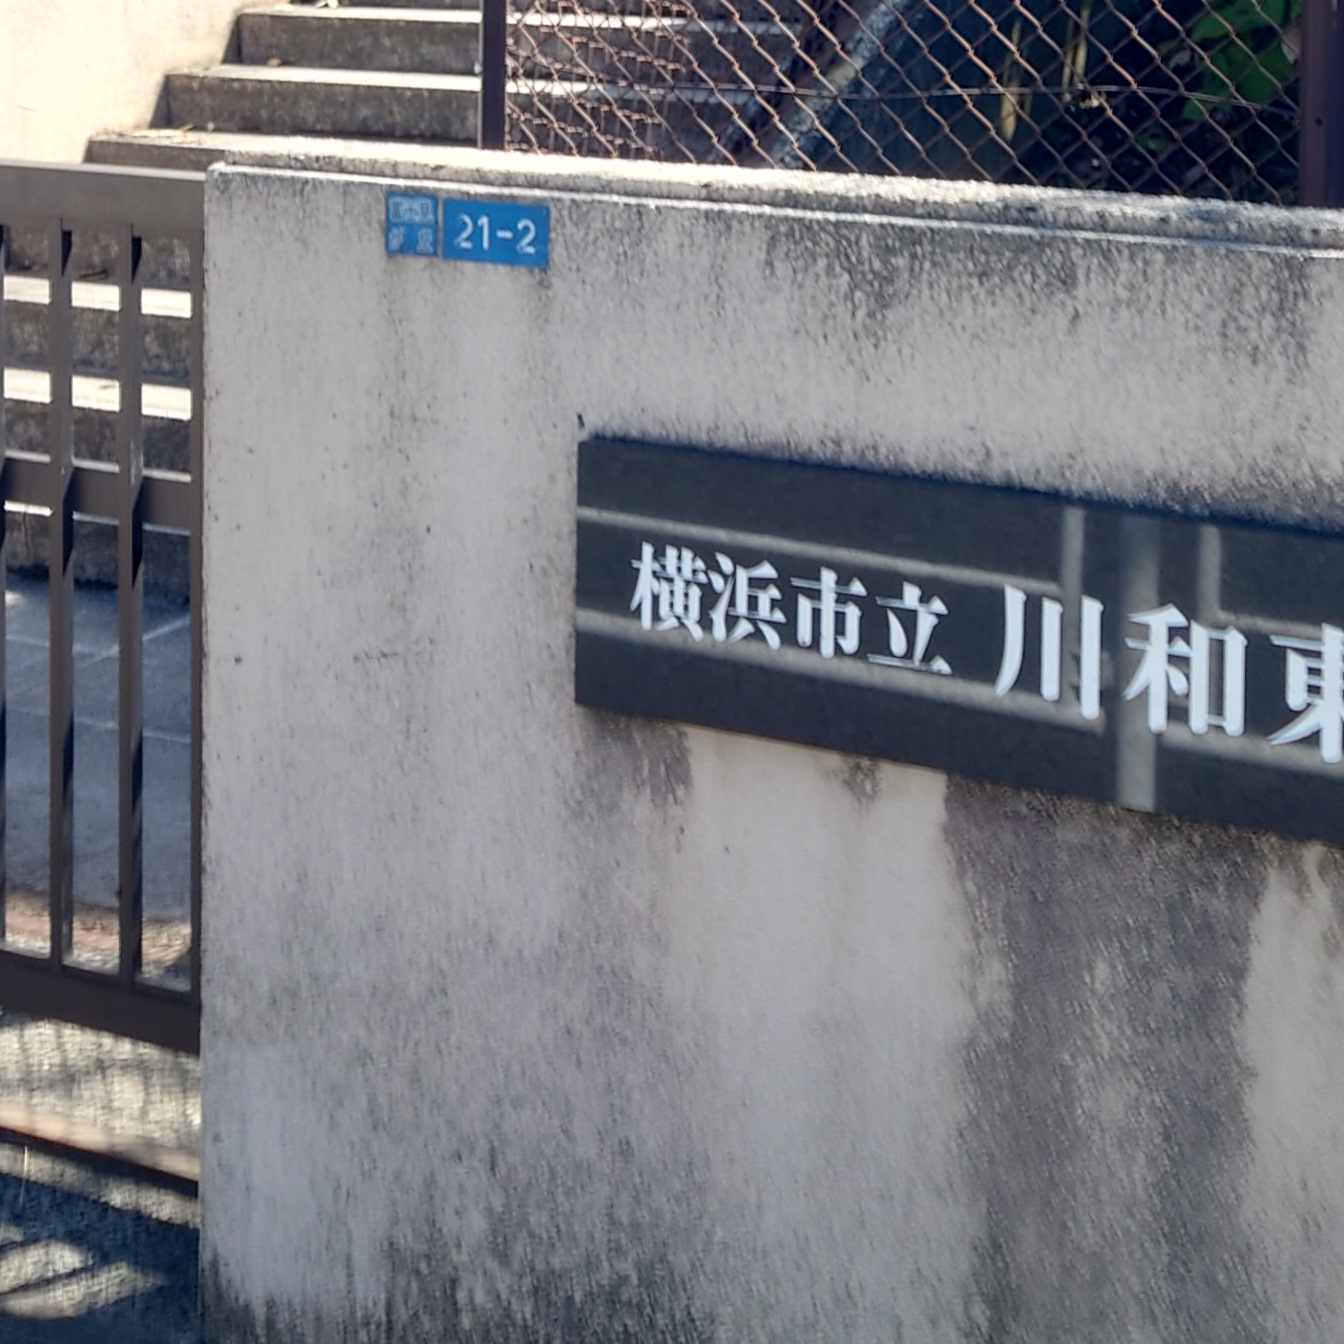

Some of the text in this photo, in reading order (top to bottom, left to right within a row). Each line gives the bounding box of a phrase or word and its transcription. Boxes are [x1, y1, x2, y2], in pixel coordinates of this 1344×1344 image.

[455, 213, 536, 254] 21-2
[630, 541, 953, 675] 横浜市立
